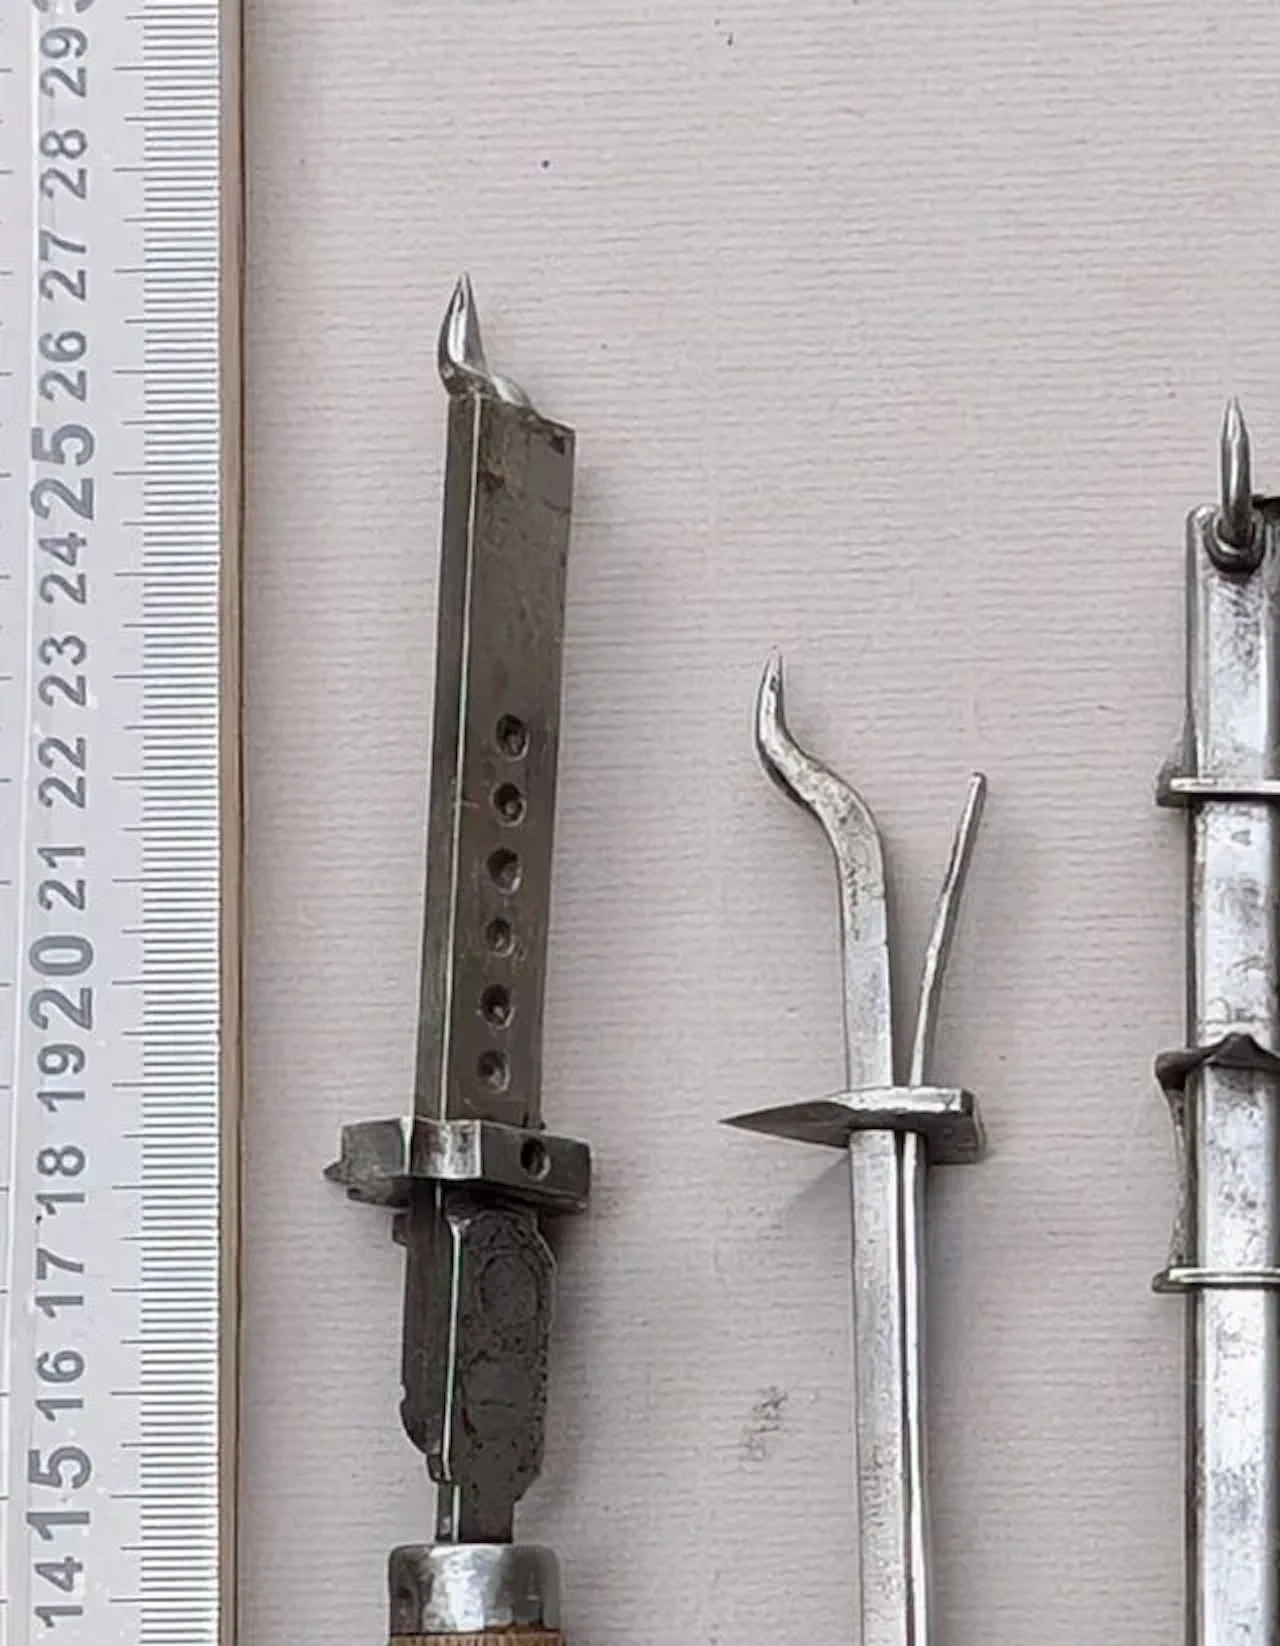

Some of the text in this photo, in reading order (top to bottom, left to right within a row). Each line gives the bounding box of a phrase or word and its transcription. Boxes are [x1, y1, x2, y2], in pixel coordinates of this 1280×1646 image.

[40, 27, 87, 98] 29
[39, 129, 88, 199] 28
[39, 229, 86, 301] 27
[39, 331, 87, 402] 26
[30, 424, 95, 521] 25
[38, 532, 87, 605] 24
[38, 635, 87, 707] 23
[38, 737, 86, 809] 22
[37, 846, 86, 910] 21
[28, 936, 93, 1030] 20
[36, 1044, 85, 1112] 19
[35, 1146, 85, 1215] 18
[35, 1248, 84, 1318] 17
[35, 1351, 85, 1422] 16
[26, 1446, 92, 1541] 15
[34, 1556, 83, 1628] 14
